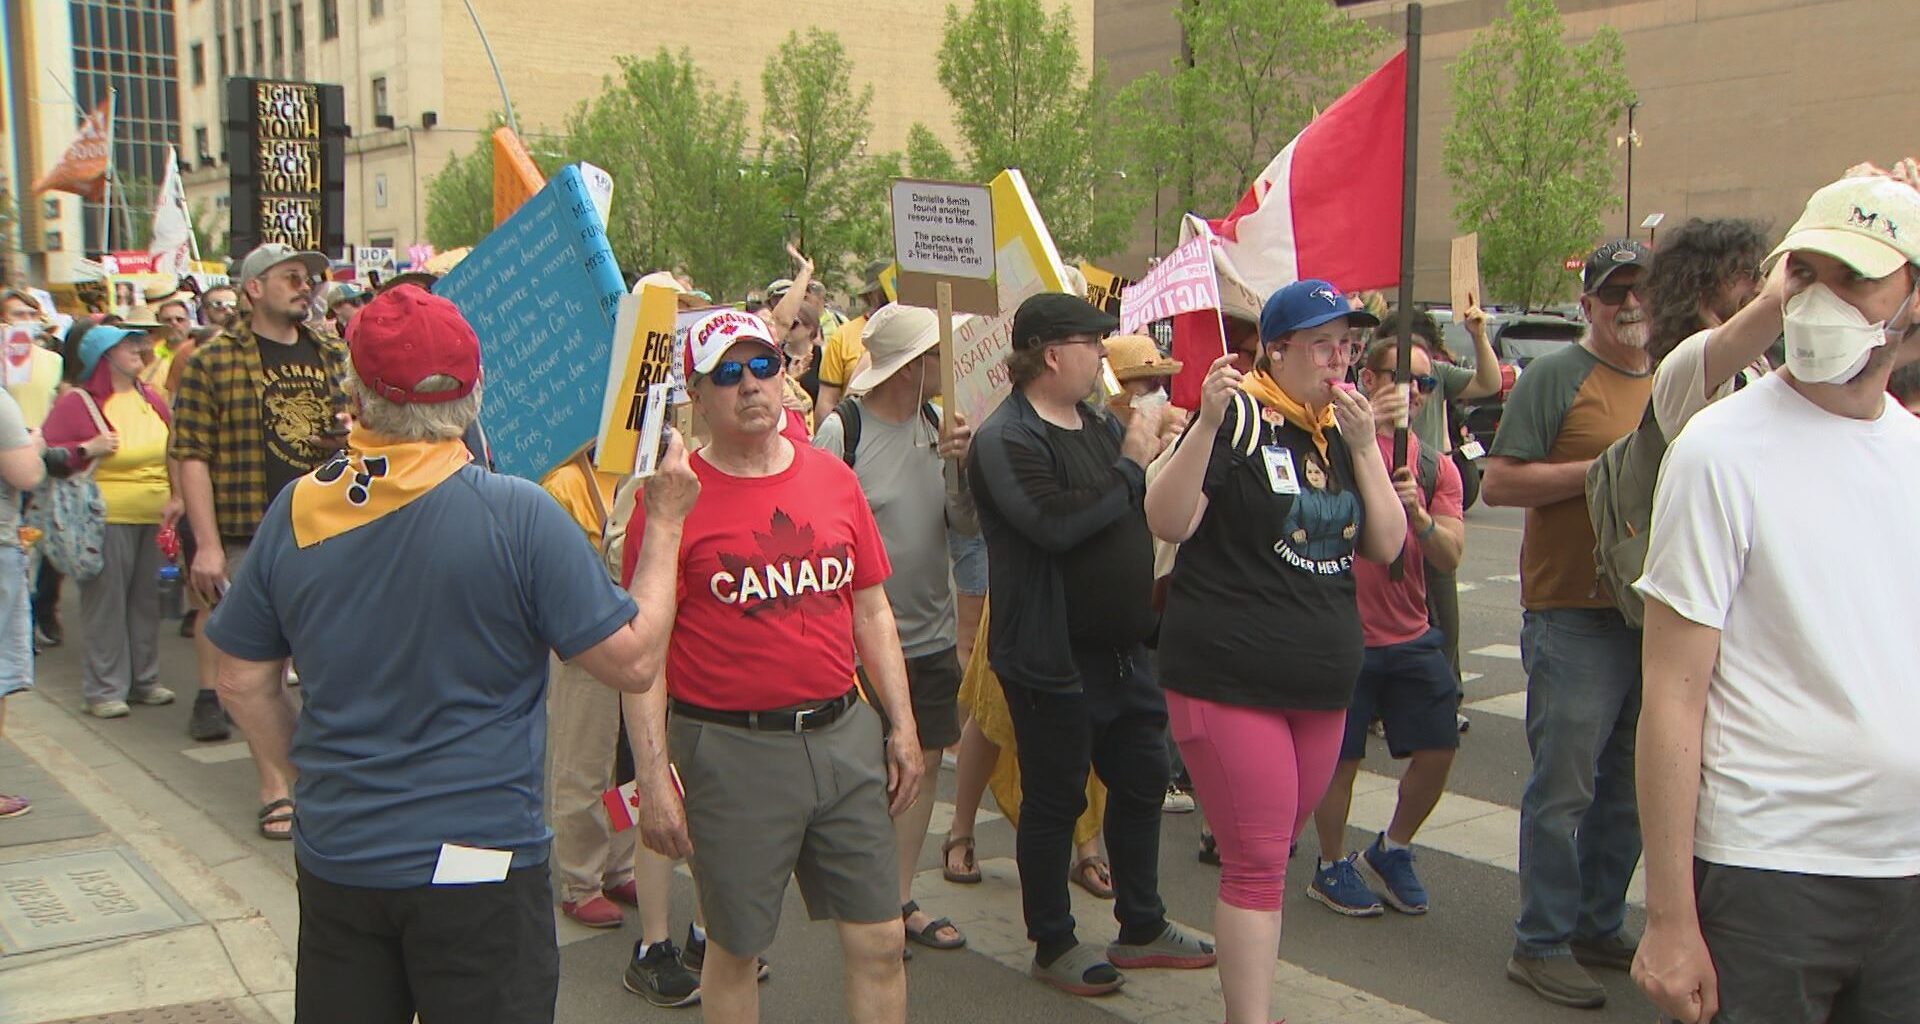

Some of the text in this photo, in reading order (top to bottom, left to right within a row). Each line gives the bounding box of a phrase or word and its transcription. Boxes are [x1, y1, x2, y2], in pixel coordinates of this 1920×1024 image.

[912, 193, 970, 206] Danielle Smith
[913, 204, 970, 216] found another
[908, 213, 943, 223] resource
[945, 216, 954, 224] to
[914, 231, 974, 245] The pockets of
[360, 249, 389, 260] UCP
[908, 250, 982, 265] 2-Tier Health Care!
[957, 246, 975, 255] with
[698, 312, 760, 347] CANADA
[281, 364, 326, 382] CHAN
[1273, 538, 1316, 574] UNDER
[1317, 560, 1341, 575] HER
[710, 556, 855, 604] CANADA
[66, 868, 140, 917] JASPER
[4, 875, 80, 928] AVENUE
